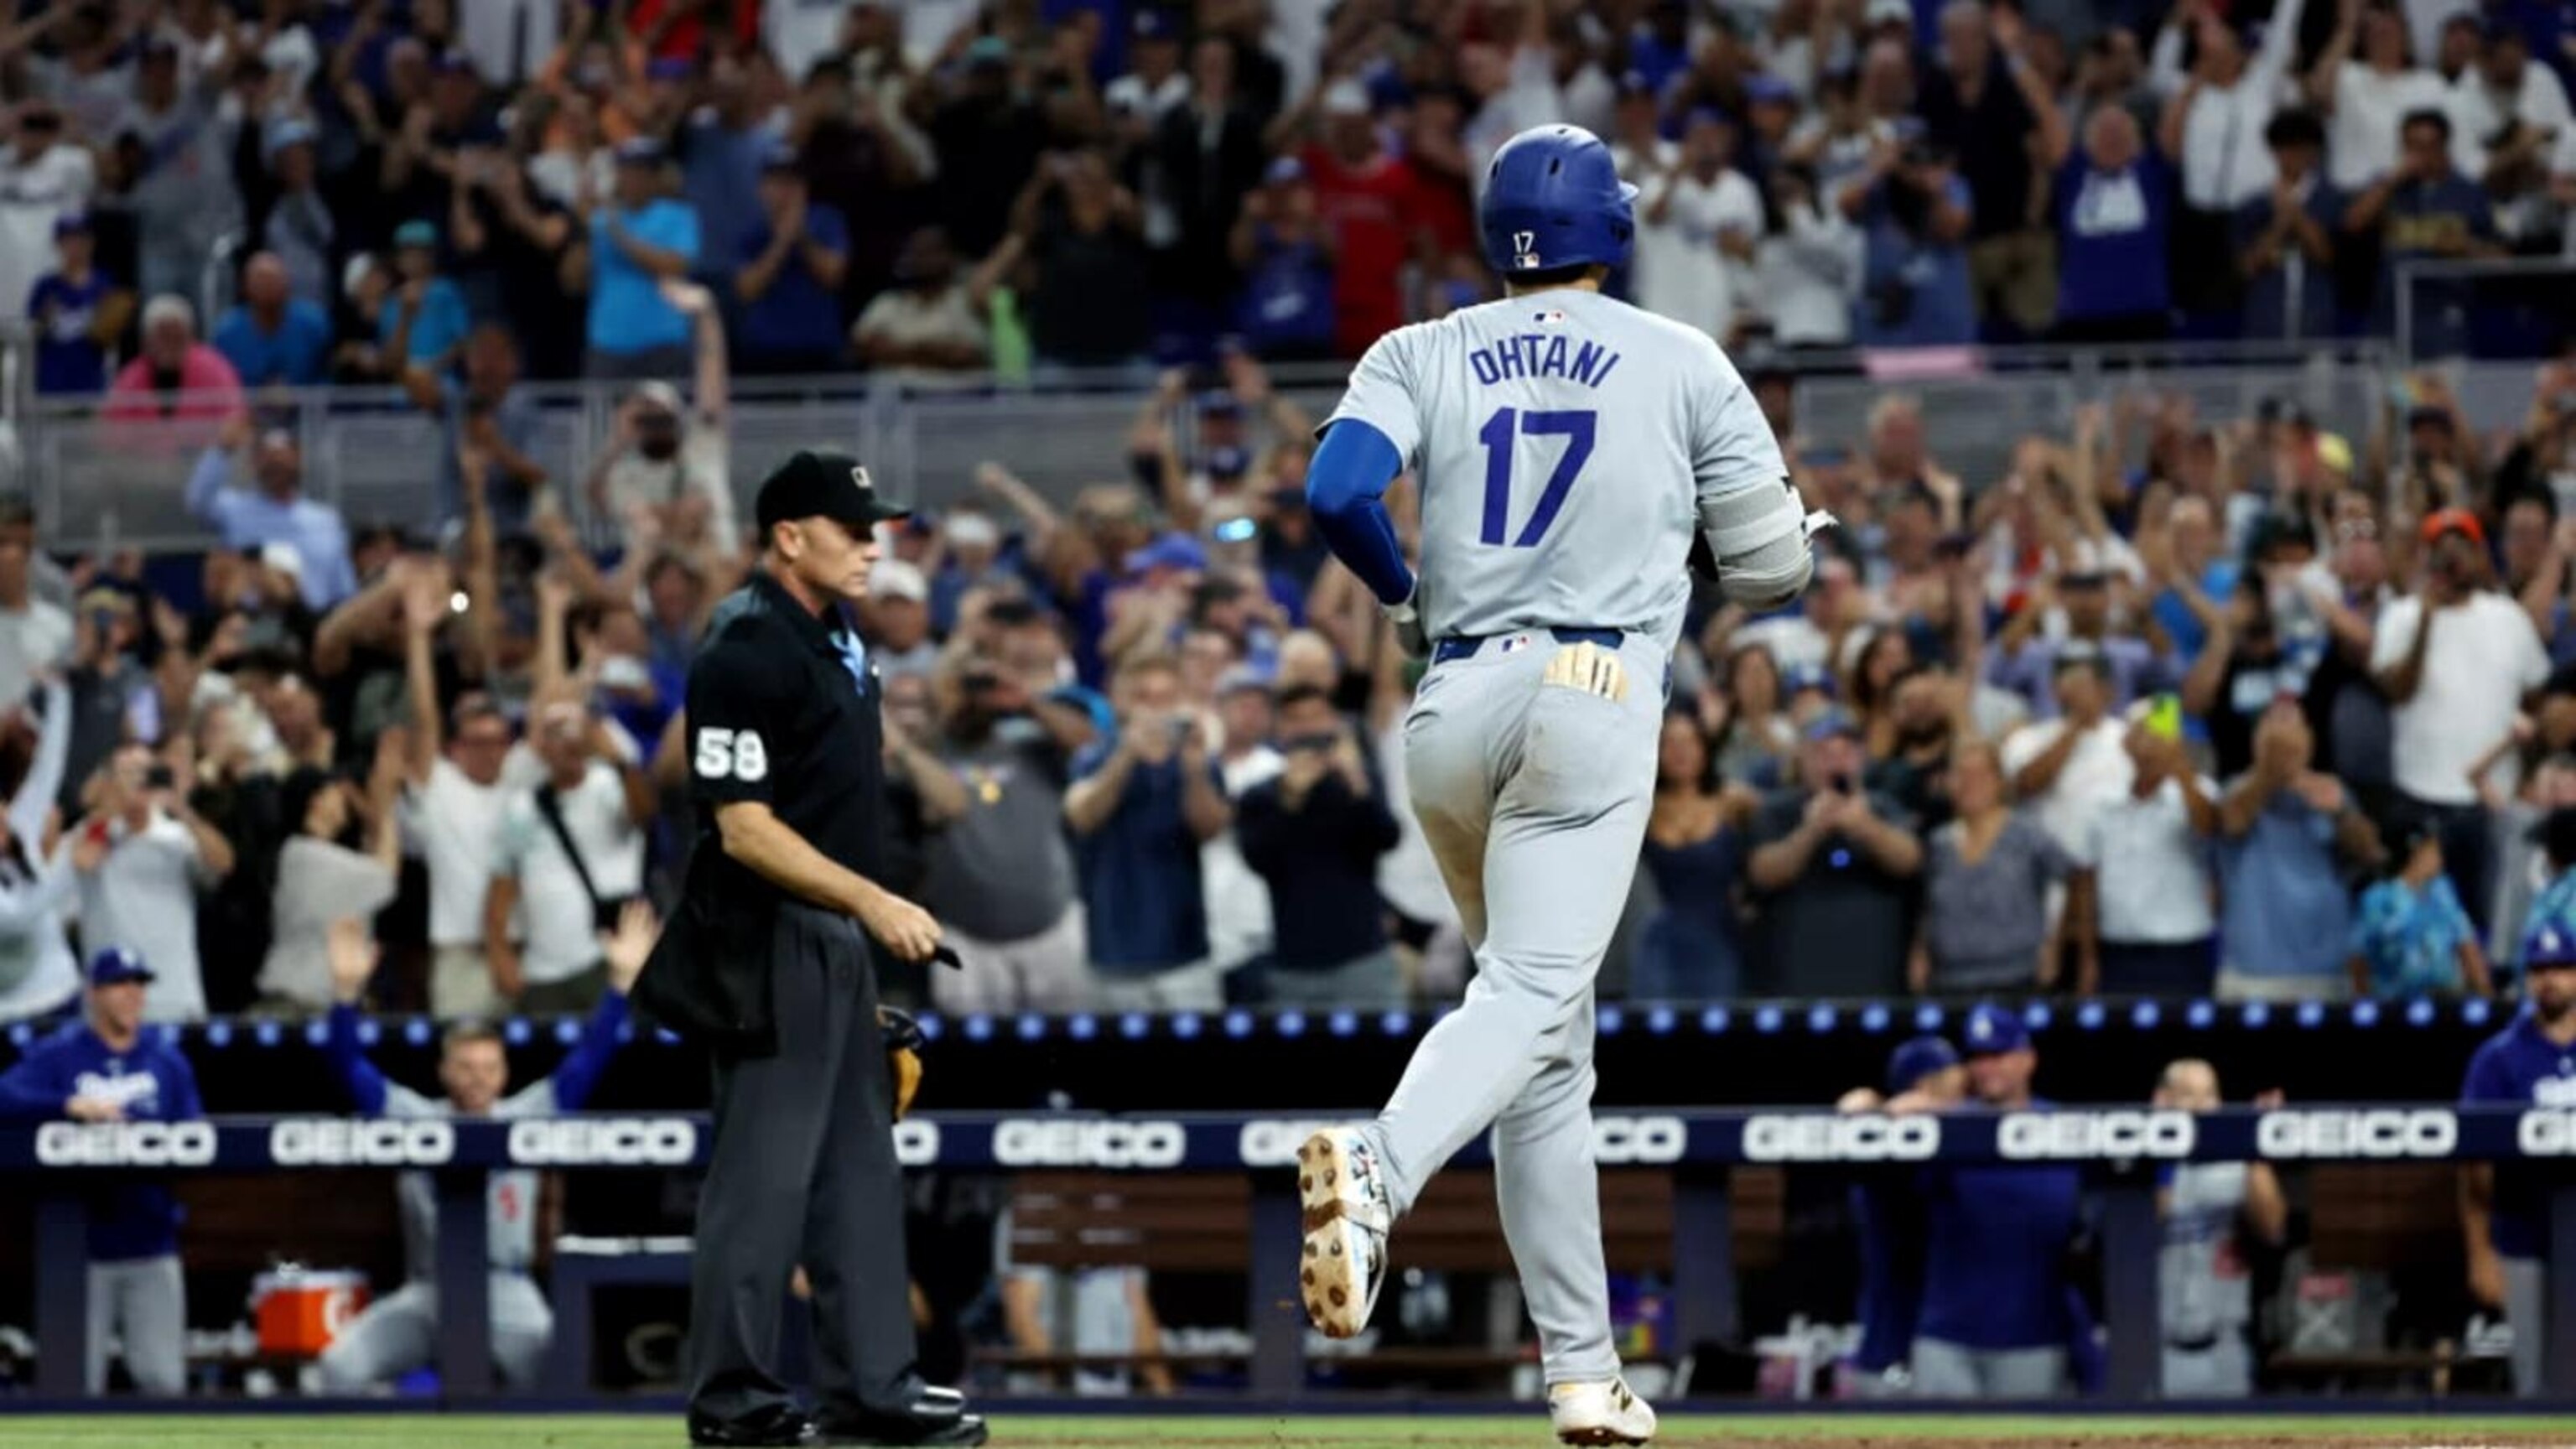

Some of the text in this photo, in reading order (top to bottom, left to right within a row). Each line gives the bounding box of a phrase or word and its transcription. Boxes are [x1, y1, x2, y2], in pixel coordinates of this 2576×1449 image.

[1513, 231, 1535, 253] 17
[1469, 334, 1620, 389] OHTANI
[1479, 406, 1597, 548] 17
[694, 726, 769, 782] 58
[35, 1120, 217, 1166] GEICO
[270, 1120, 454, 1165] GEICO
[508, 1119, 696, 1165] GEICO
[992, 1119, 1186, 1166] GEICO
[1742, 1114, 1941, 1161] GEICO
[1997, 1110, 2196, 1159] GEICO
[2257, 1108, 2458, 1157] GEICO
